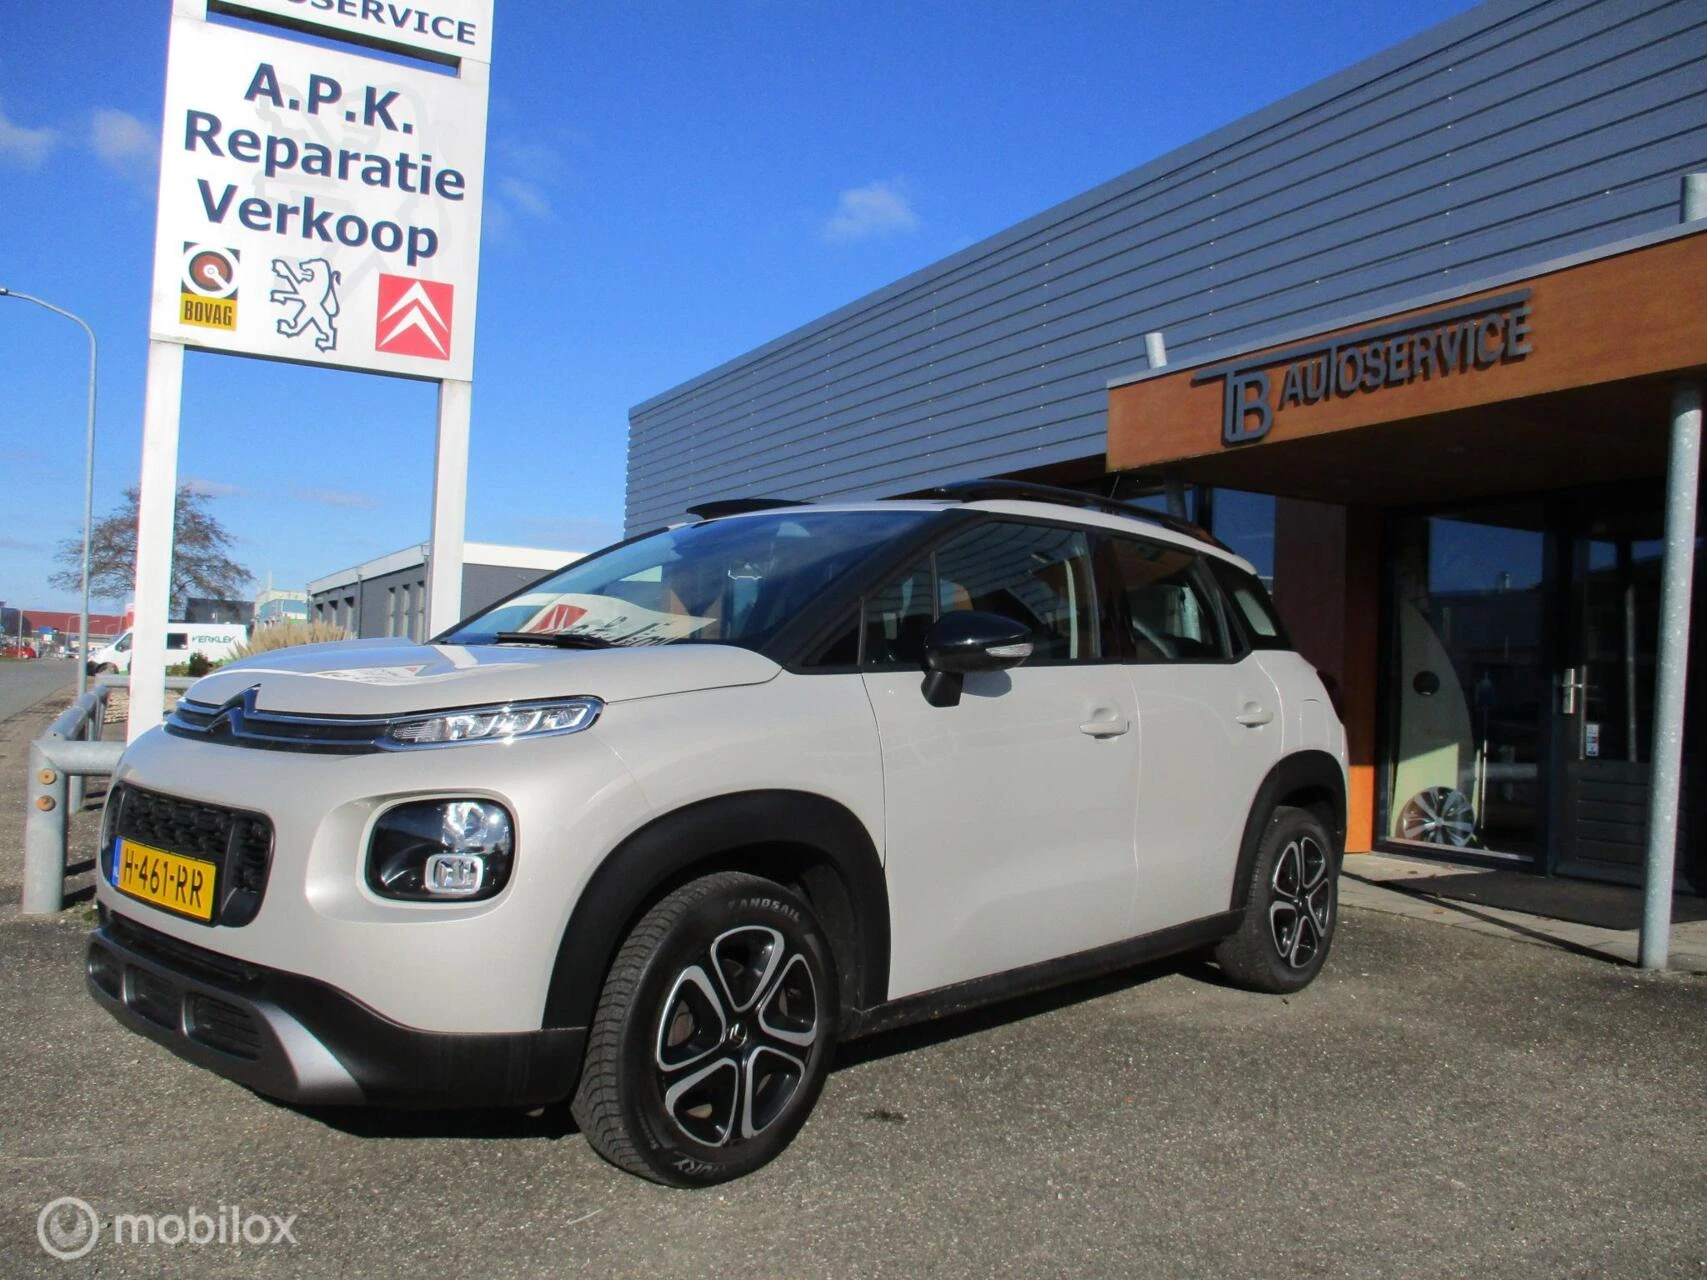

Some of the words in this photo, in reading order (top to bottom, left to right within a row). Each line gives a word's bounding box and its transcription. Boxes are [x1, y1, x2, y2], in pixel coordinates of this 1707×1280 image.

[289, 0, 477, 45] ERVICE
[243, 62, 414, 135] A.P.K.
[184, 109, 466, 201] Reparatie
[197, 178, 439, 267] Verkoop
[184, 300, 232, 325] BOVAG
[1280, 305, 1533, 399] AUTOSERVICE
[122, 848, 204, 908] H-461-RR
